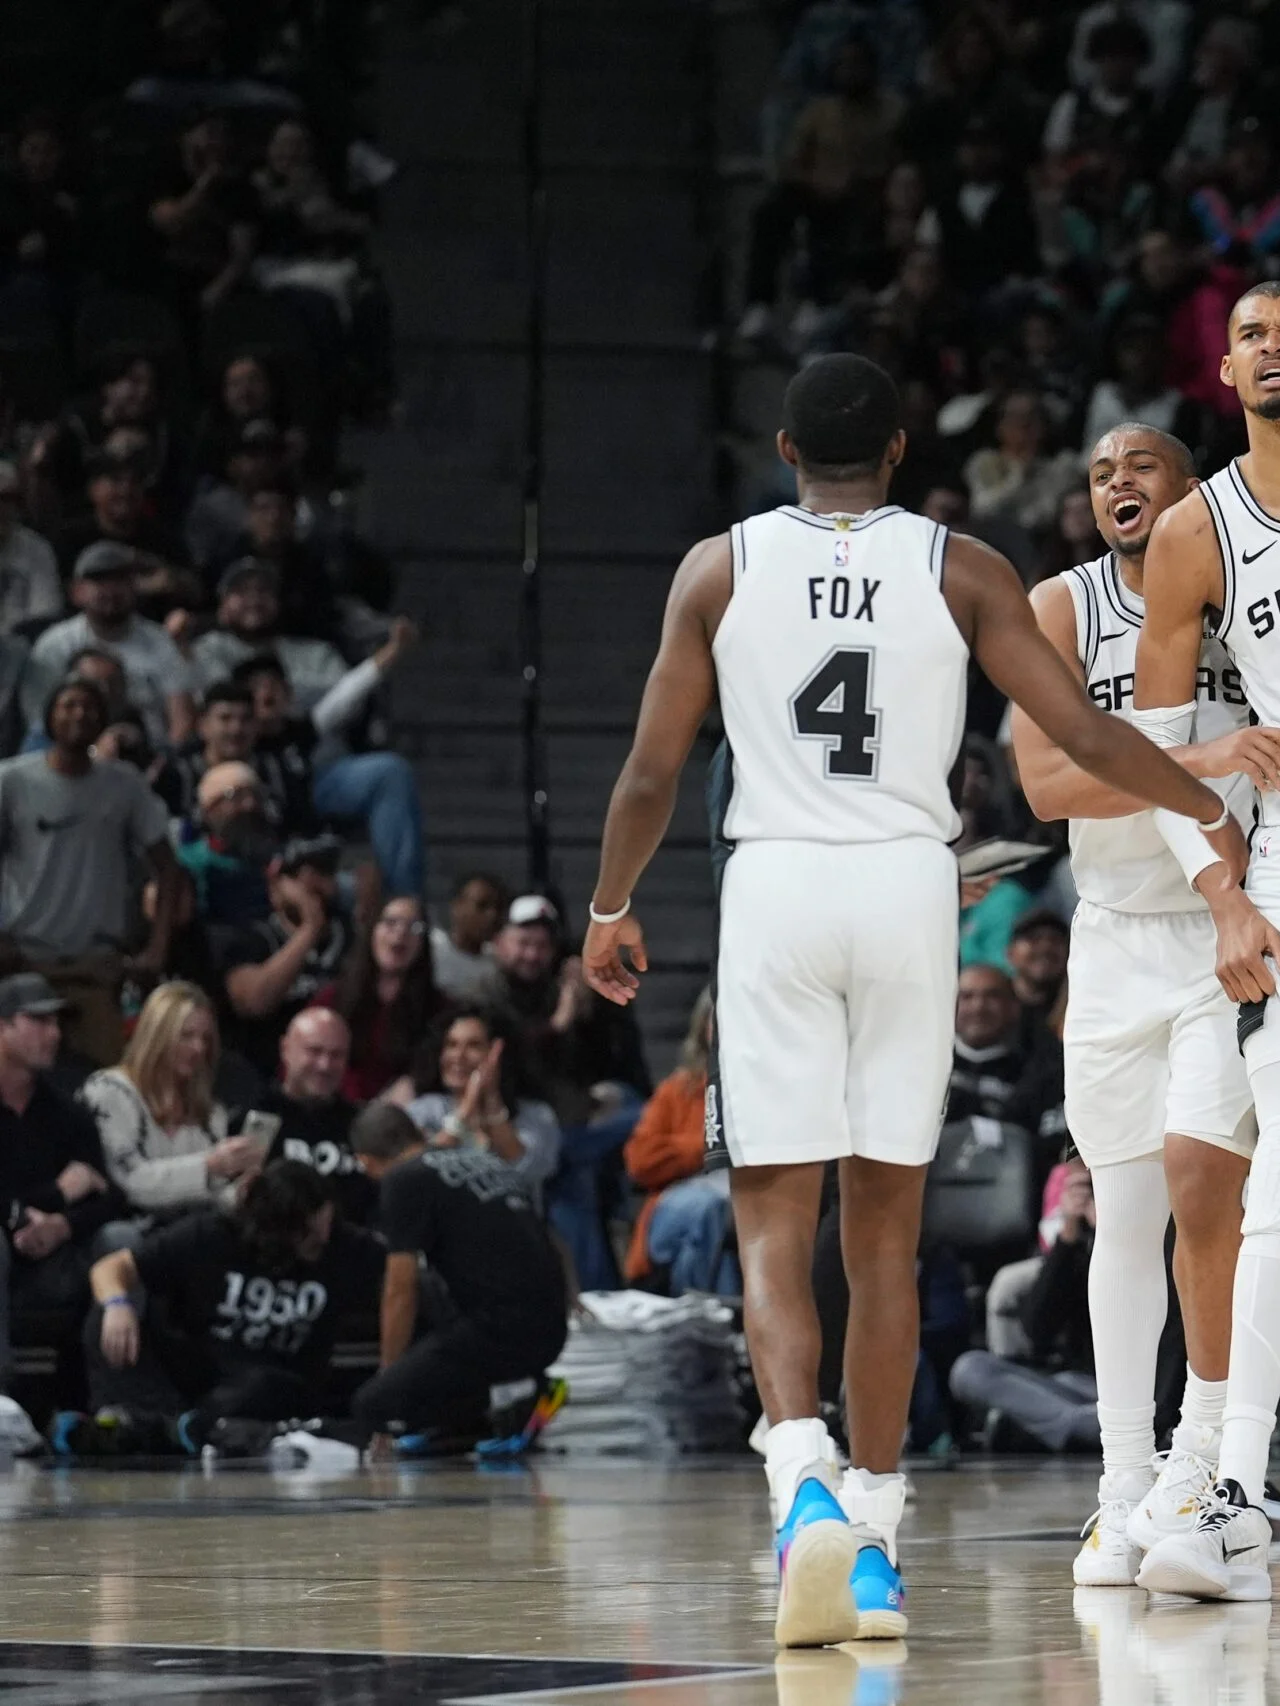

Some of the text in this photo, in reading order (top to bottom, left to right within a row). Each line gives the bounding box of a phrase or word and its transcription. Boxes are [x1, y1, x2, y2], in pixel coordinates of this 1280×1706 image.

[808, 576, 881, 622] FOX
[787, 644, 884, 782] 4
[1087, 667, 1249, 712] SPRS
[215, 1270, 328, 1325] 1950
